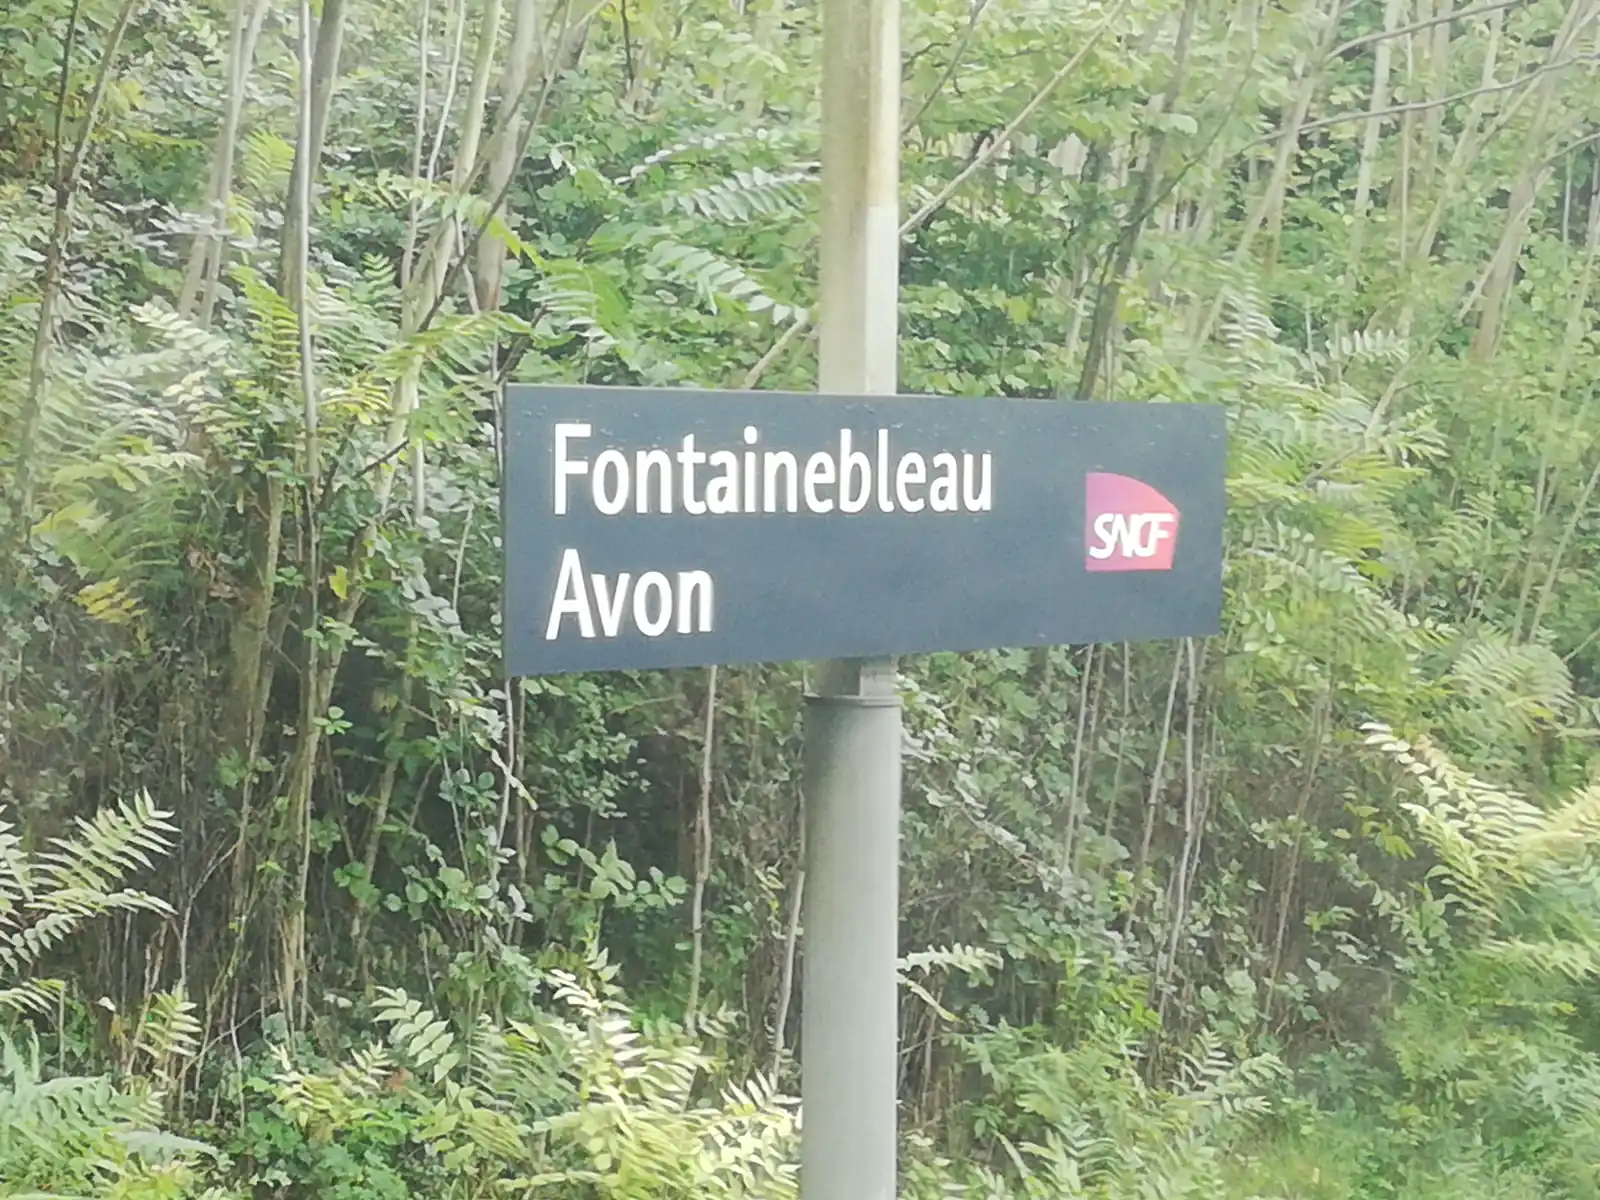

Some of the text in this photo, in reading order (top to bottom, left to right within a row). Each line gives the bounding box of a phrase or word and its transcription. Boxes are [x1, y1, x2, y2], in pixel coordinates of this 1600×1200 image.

[551, 422, 994, 515] Fontainebleau
[1089, 512, 1176, 560] SNCF
[546, 548, 713, 640] Avon
